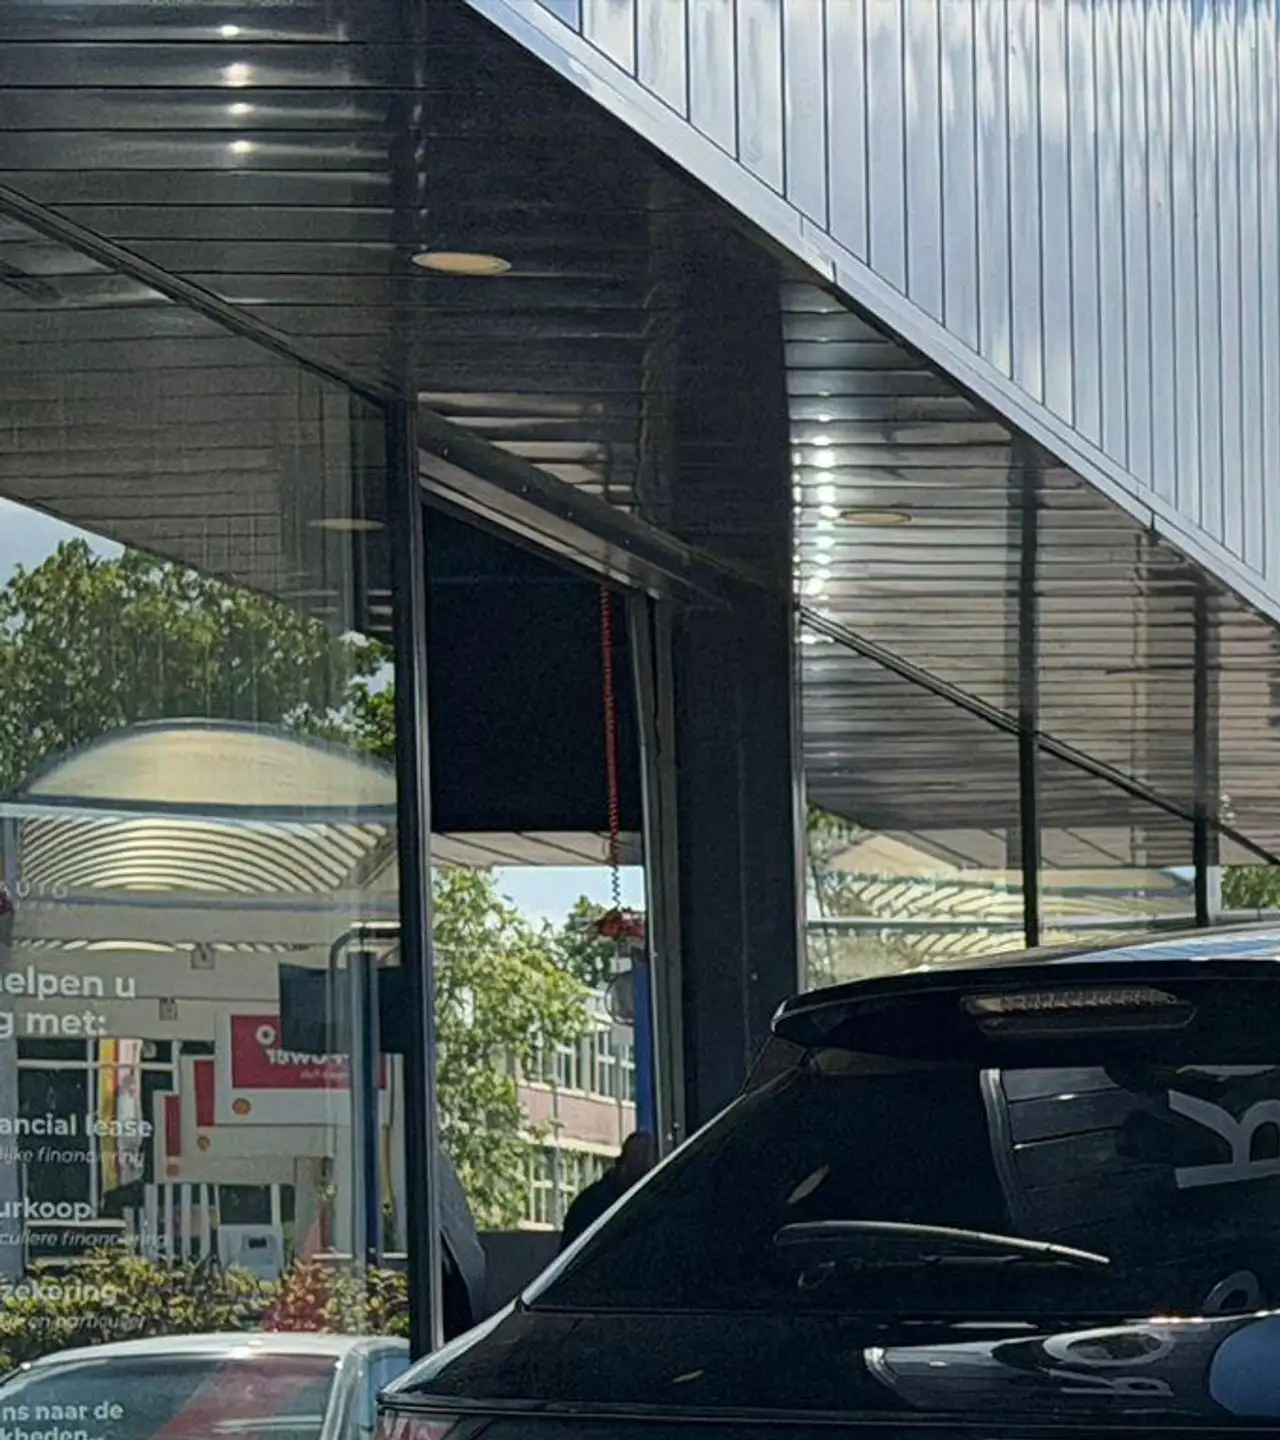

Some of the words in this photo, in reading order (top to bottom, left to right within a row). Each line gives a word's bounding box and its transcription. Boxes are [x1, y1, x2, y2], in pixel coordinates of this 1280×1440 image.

[0, 965, 104, 1001] elpen
[115, 977, 136, 998] u
[26, 1010, 107, 1035] met:
[85, 1113, 153, 1137] lease
[35, 1404, 88, 1421] naar
[93, 1400, 125, 1420] de
